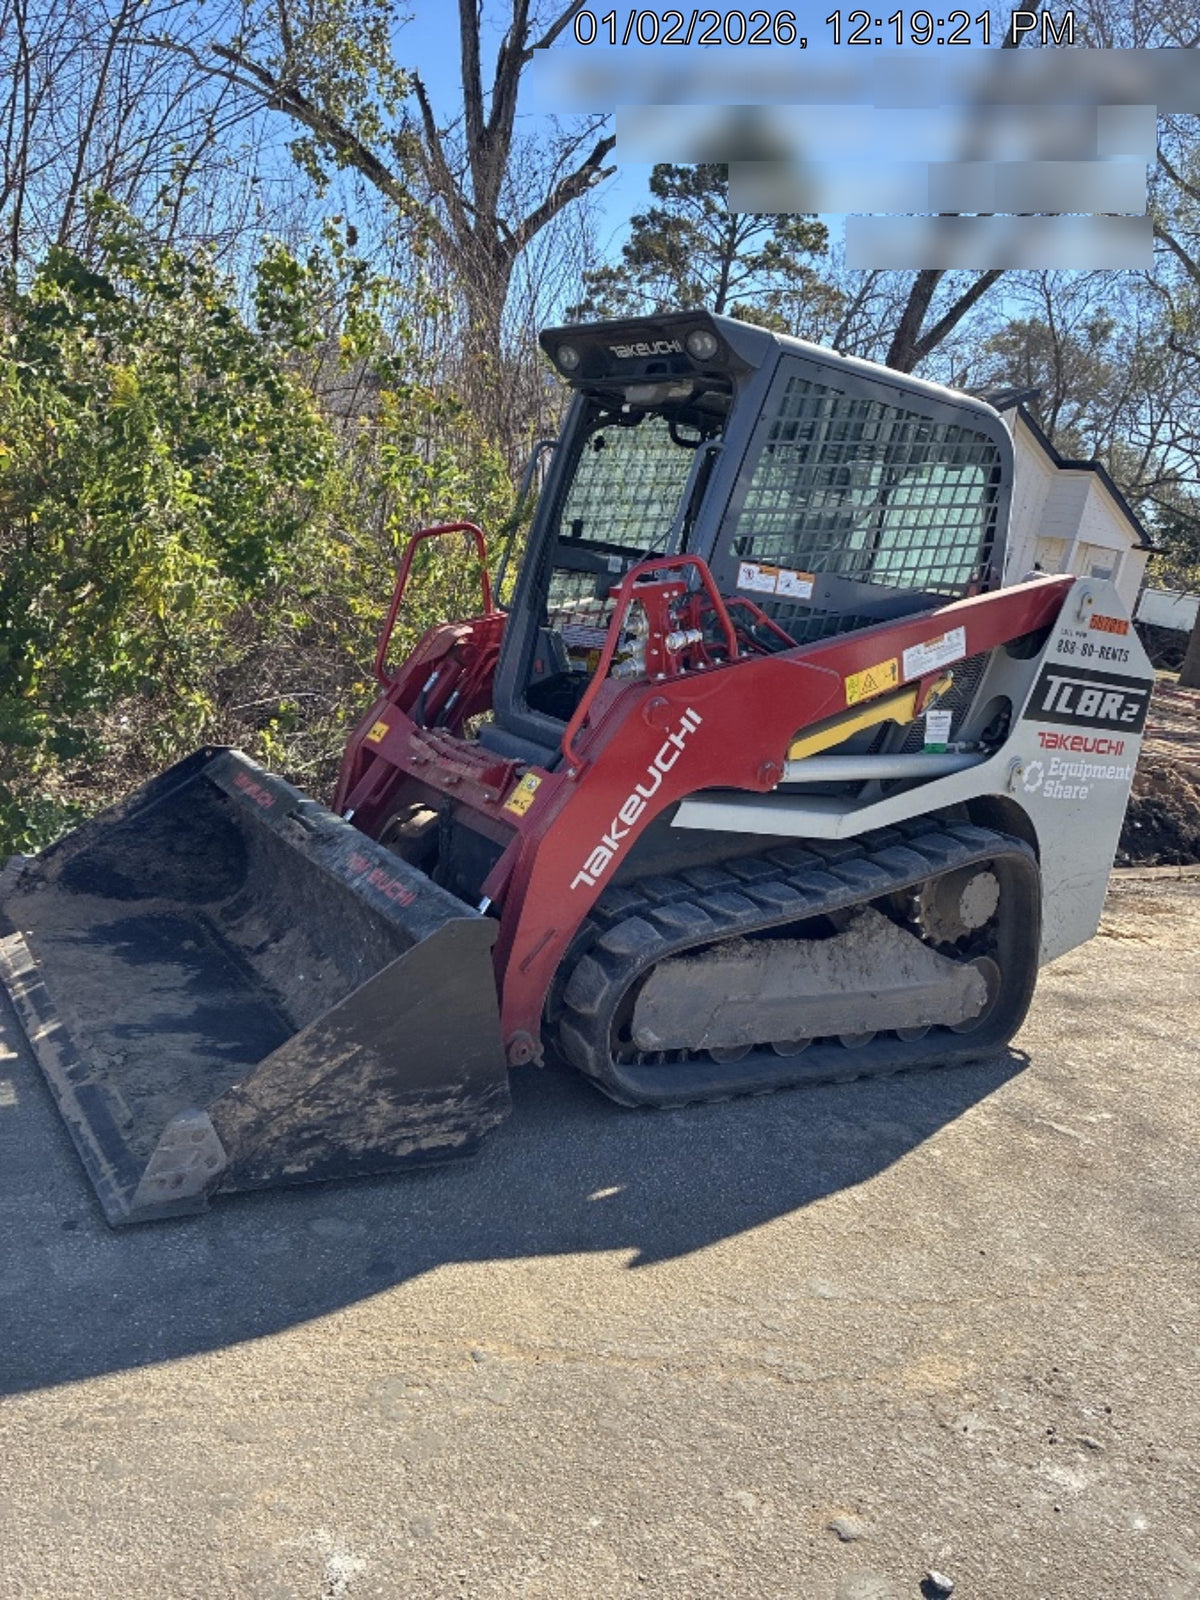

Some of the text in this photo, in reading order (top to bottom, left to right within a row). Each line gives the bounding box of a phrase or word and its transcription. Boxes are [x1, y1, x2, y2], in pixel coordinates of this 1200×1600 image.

[609, 339, 683, 359] TAKEUCHI
[1038, 731, 1125, 756] TAKEUCHI
[1047, 757, 1132, 782] Equipment
[570, 707, 703, 890] TAKEUCHI
